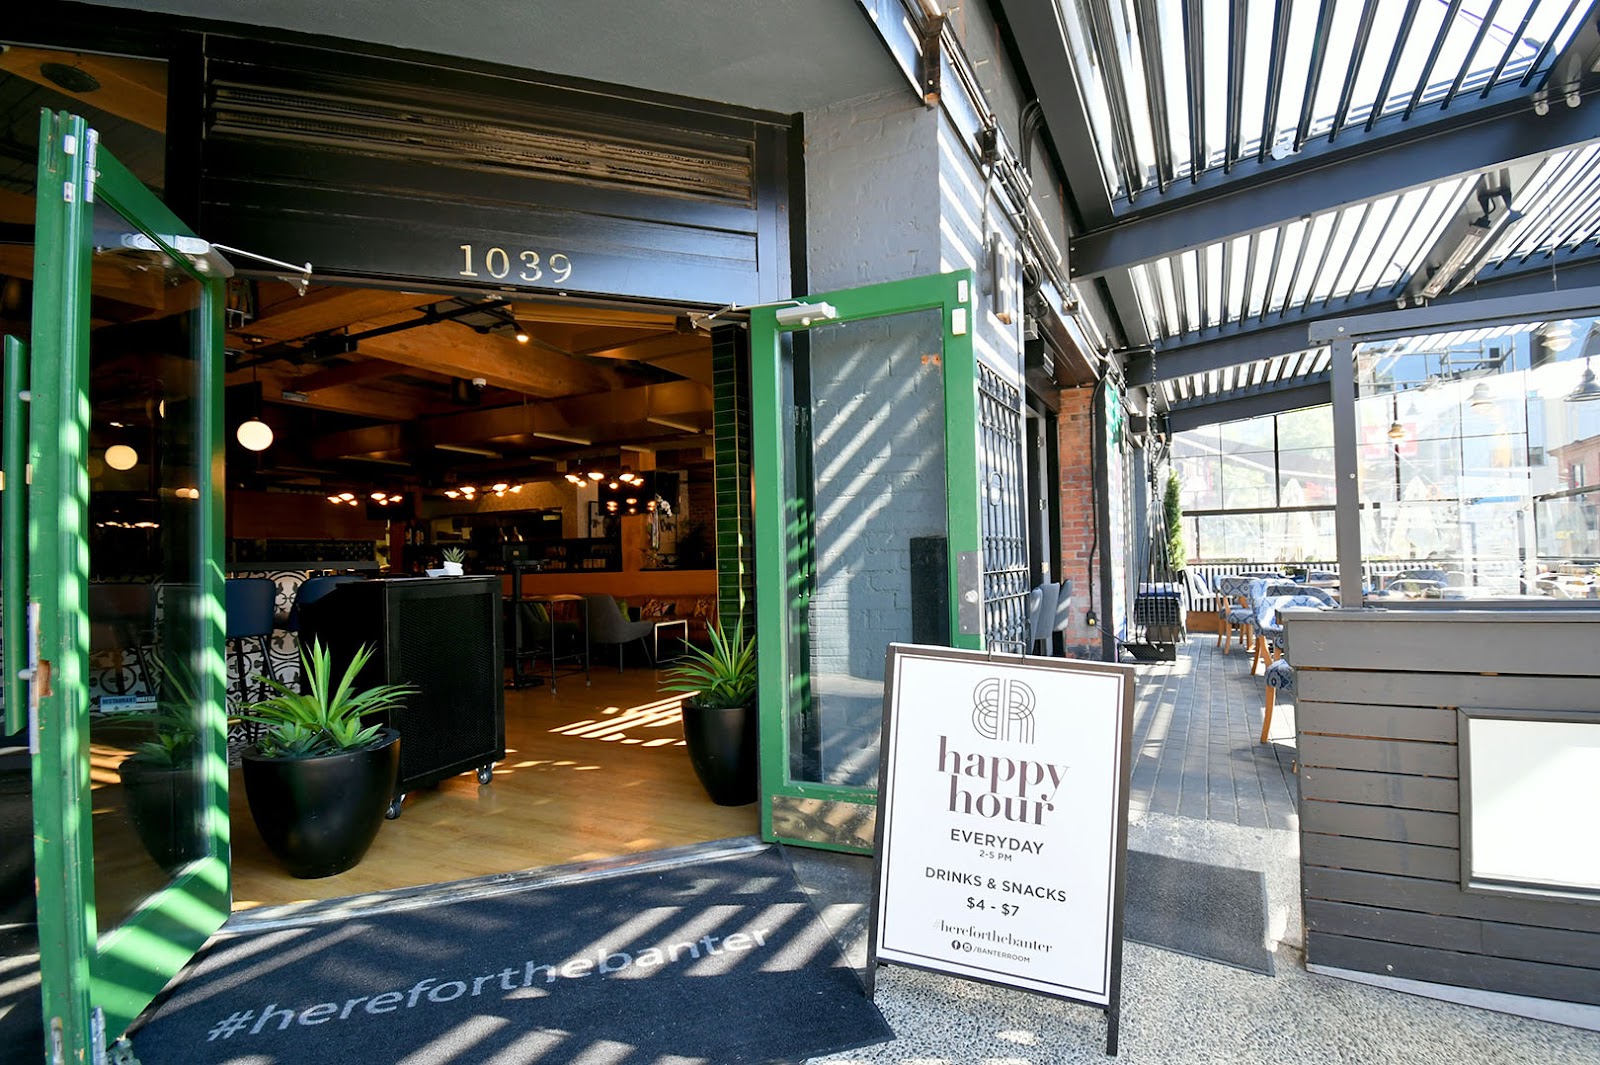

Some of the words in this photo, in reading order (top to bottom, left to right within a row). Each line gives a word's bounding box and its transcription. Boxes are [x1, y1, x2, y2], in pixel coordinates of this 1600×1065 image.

[459, 244, 572, 284] 1039
[936, 734, 1071, 802] happy
[946, 774, 1055, 826] hour
[950, 828, 1044, 855] EVERYDAY
[979, 849, 996, 860] 2-5
[997, 852, 1013, 863] PM
[925, 866, 983, 888] DRINKS
[986, 877, 998, 890] &
[1001, 880, 1067, 903] SNACKS
[966, 896, 986, 911] $4
[1001, 902, 1020, 917] $7
[932, 918, 1053, 953] #hereforthebanter
[206, 926, 774, 1042] #hereforthebanter
